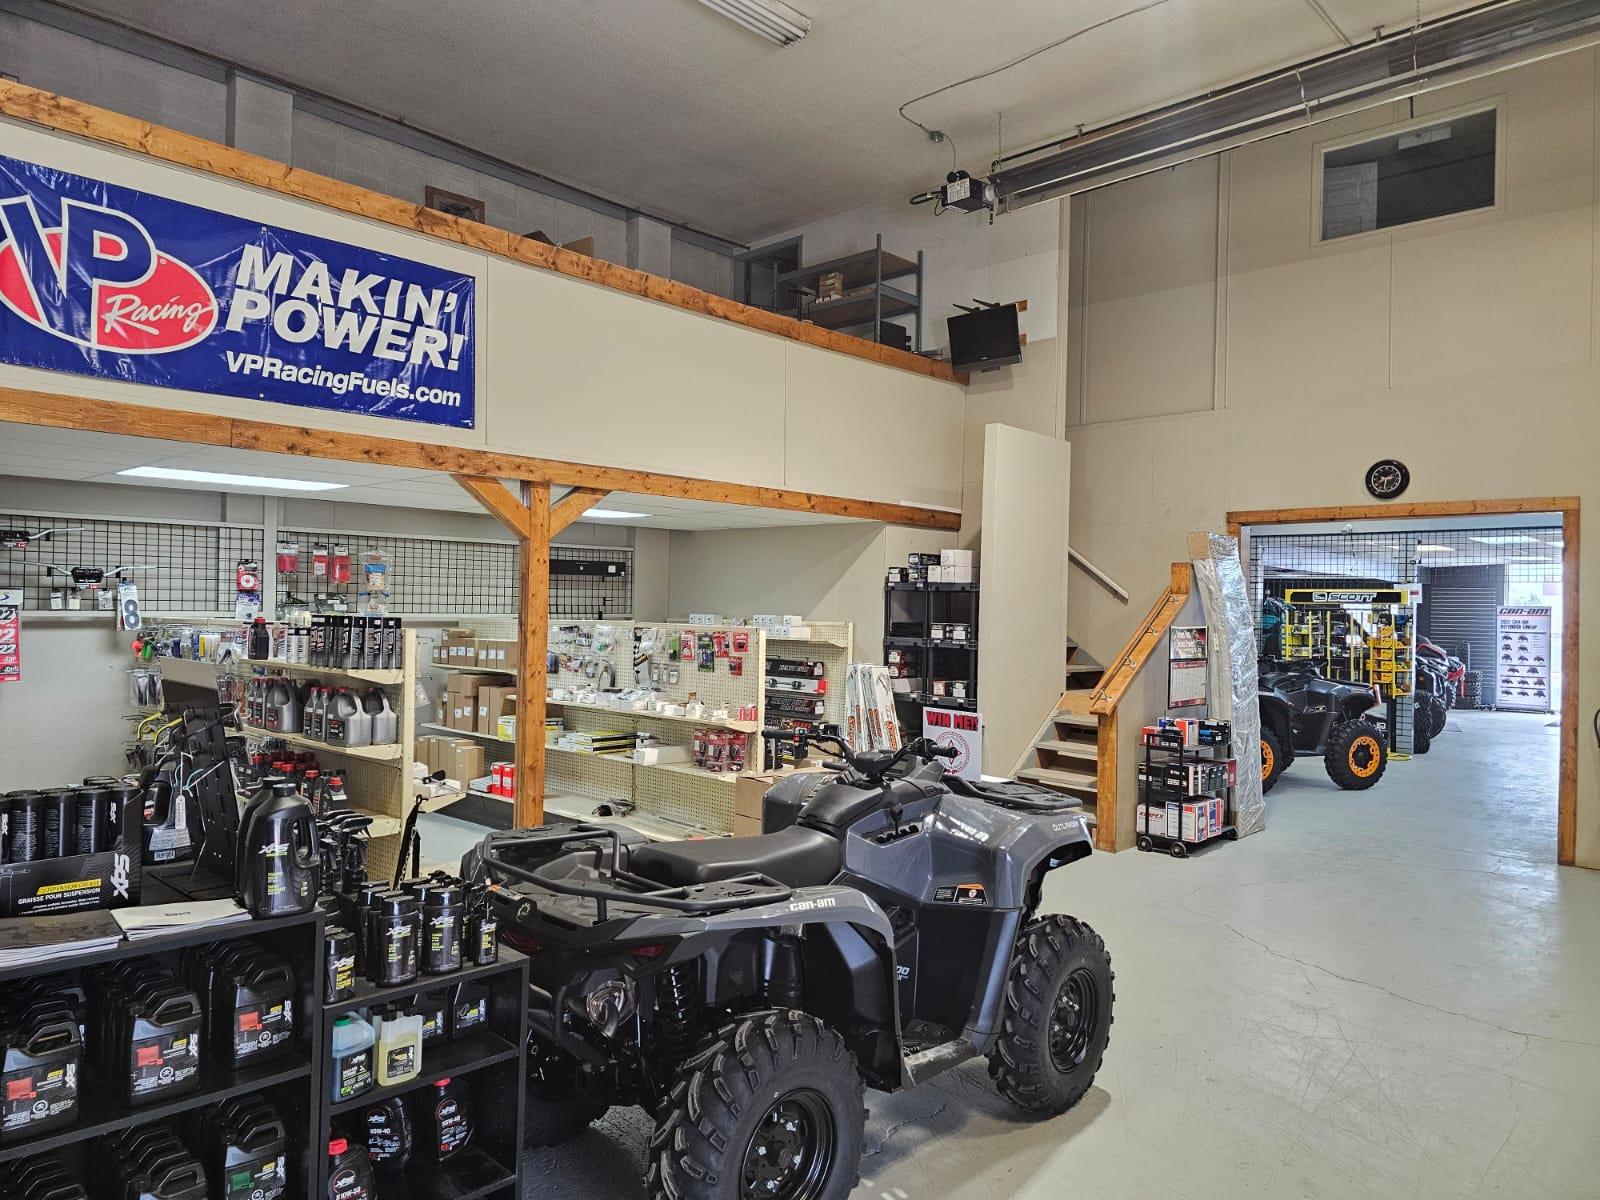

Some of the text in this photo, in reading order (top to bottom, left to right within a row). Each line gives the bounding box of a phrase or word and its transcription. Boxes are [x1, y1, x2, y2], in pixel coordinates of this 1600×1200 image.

[0, 194, 157, 347] VP
[235, 244, 458, 327] MAKIN'
[104, 294, 205, 335] Racing
[226, 288, 466, 371] POWER!
[225, 350, 461, 406] VPRacingFuels.com
[124, 599, 140, 629] 8
[1328, 592, 1377, 602] SCOTT
[926, 711, 951, 728] WIN
[18, 888, 101, 905] GRAISSE POUR SUSPENSION
[110, 852, 130, 900] XPS
[790, 898, 836, 911] can-am
